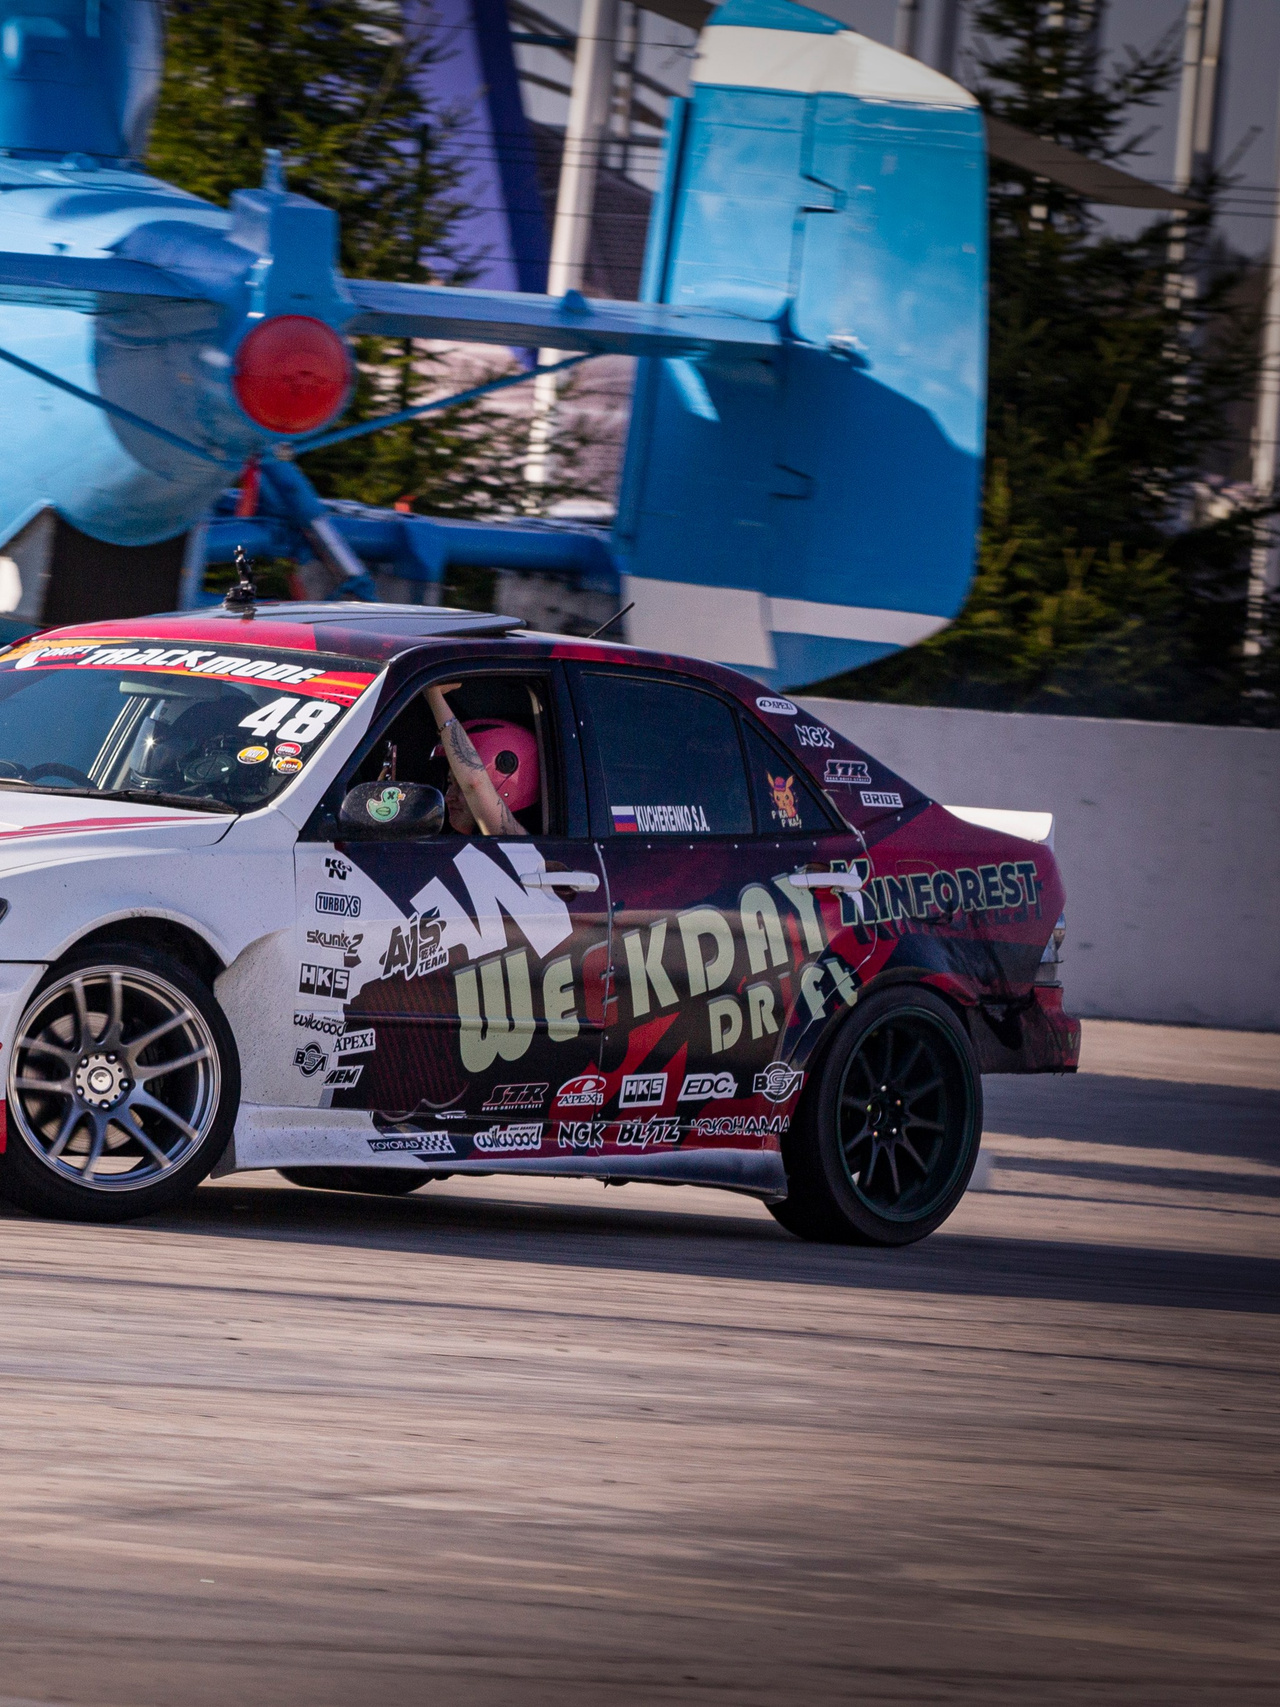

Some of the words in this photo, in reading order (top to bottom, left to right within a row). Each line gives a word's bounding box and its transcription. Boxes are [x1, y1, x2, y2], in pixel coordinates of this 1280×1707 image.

[238, 696, 341, 743] 48
[794, 724, 835, 749] NGK
[862, 793, 901, 805] BRIDE
[634, 805, 693, 832] KUCHERENKO
[691, 805, 710, 832] S.A.
[418, 952, 447, 973] TEAM
[299, 963, 349, 993] HKS
[324, 1068, 360, 1085] AEM
[623, 1078, 665, 1103] HKS
[476, 1125, 541, 1148] wilwood
[558, 1121, 607, 1149] NGK
[616, 1112, 680, 1150] BLITZ
[690, 1115, 790, 1136] YOKOHAMA
[370, 1140, 420, 1151] KOYORAD
